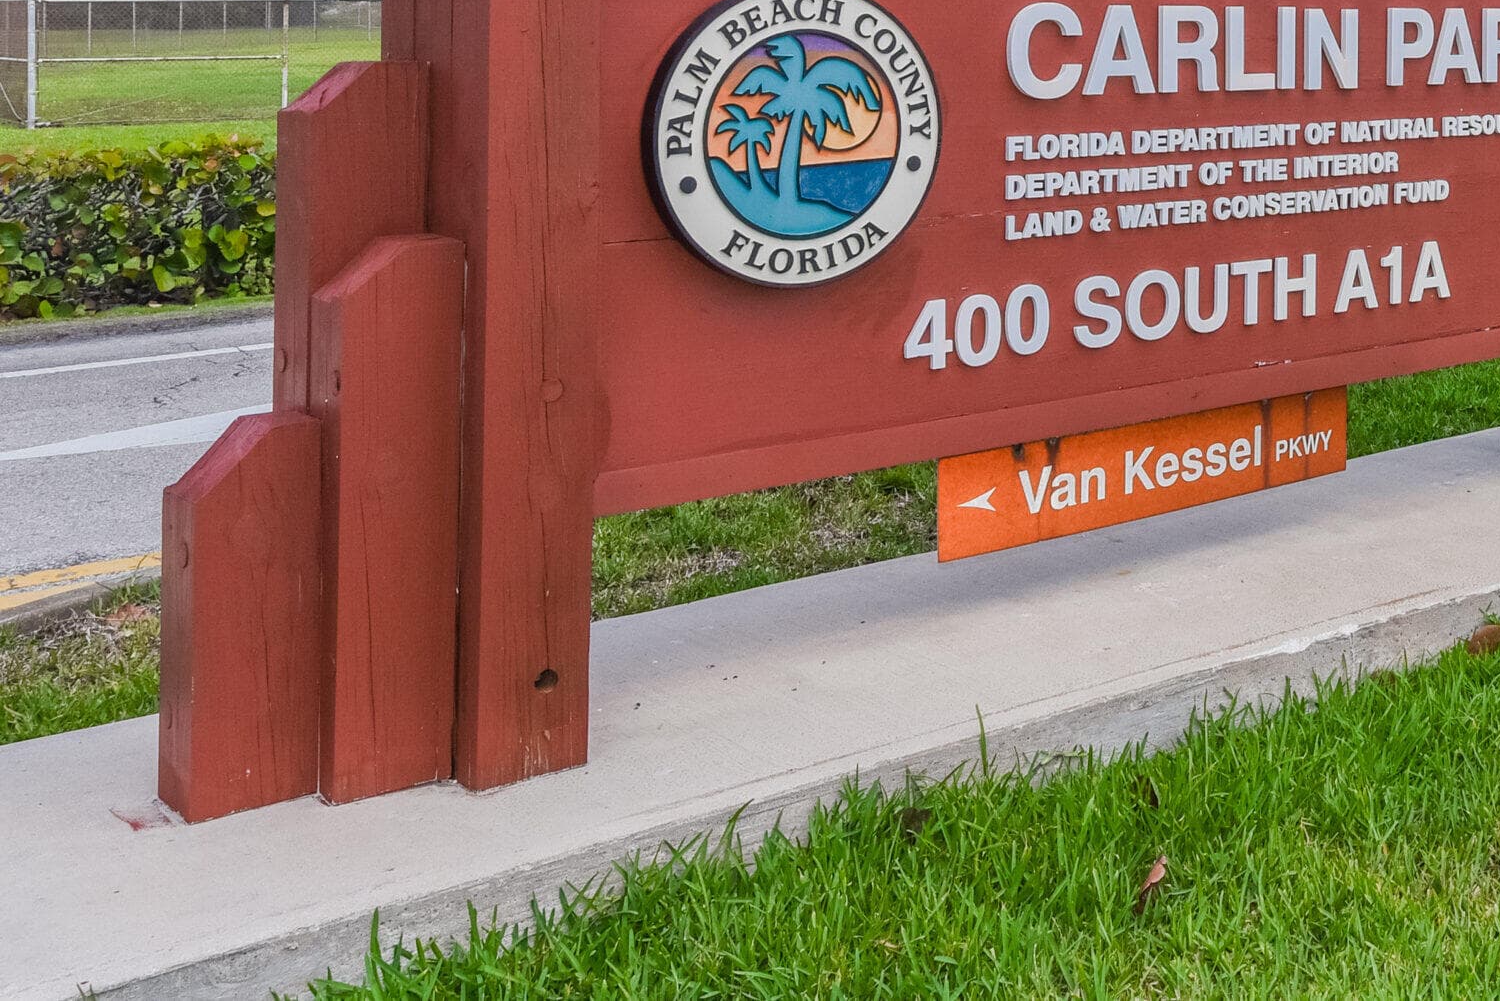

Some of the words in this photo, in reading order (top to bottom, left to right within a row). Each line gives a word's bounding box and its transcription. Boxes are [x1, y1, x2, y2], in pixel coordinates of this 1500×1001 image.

[667, 47, 721, 158] PALM
[854, 13, 932, 140] COUNTY
[1006, 1, 1359, 100] CARLIN
[1004, 164, 1194, 200] DEPARTMENT
[1199, 161, 1234, 186] OF
[1239, 158, 1289, 182] THE
[1293, 151, 1400, 179] INTERIOR
[1005, 131, 1126, 161] FLORIDA
[1131, 123, 1299, 155] DEPARTMENT
[1304, 122, 1337, 145] OF
[1340, 117, 1440, 144] NATURAL
[720, 221, 889, 275] FLORIDA
[1004, 209, 1083, 241] LAND
[1089, 205, 1112, 233] &
[1117, 199, 1206, 231] WATER
[1212, 185, 1390, 221] CONSERVATION
[1392, 179, 1451, 204] FUND
[902, 284, 1051, 370] 400
[1072, 253, 1317, 349] SOUTH
[1333, 240, 1452, 314] A1A
[1018, 465, 1107, 515] Van
[1123, 425, 1263, 496] Kessel
[1275, 429, 1333, 463] PKWY
